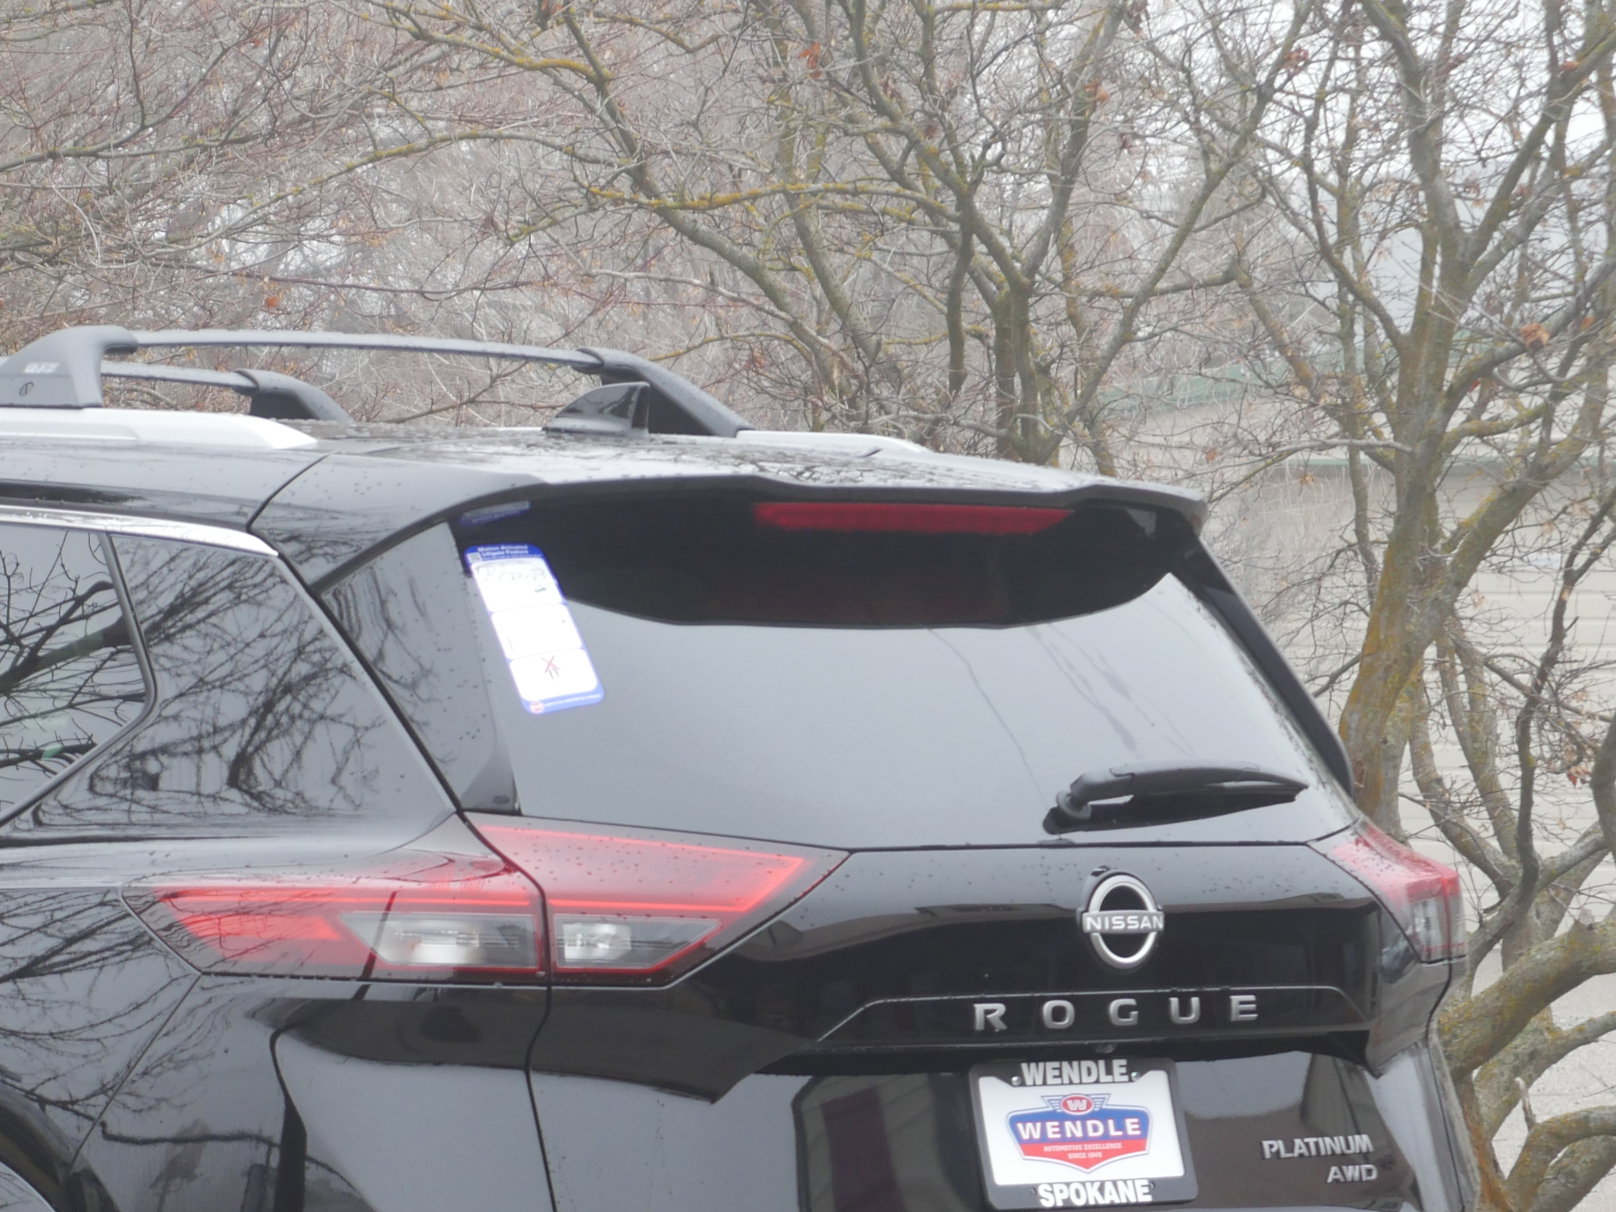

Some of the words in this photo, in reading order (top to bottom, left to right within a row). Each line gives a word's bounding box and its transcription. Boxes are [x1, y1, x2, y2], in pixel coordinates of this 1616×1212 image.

[1086, 914, 1164, 931] NISSAN
[973, 995, 1259, 1032] ROGUE
[1020, 1058, 1130, 1086] WENDLE
[1016, 1118, 1141, 1140] WENDLE
[1261, 1133, 1375, 1159] PLATINUM
[1326, 1163, 1379, 1184] AWD
[1037, 1178, 1153, 1208] SPOKANE
